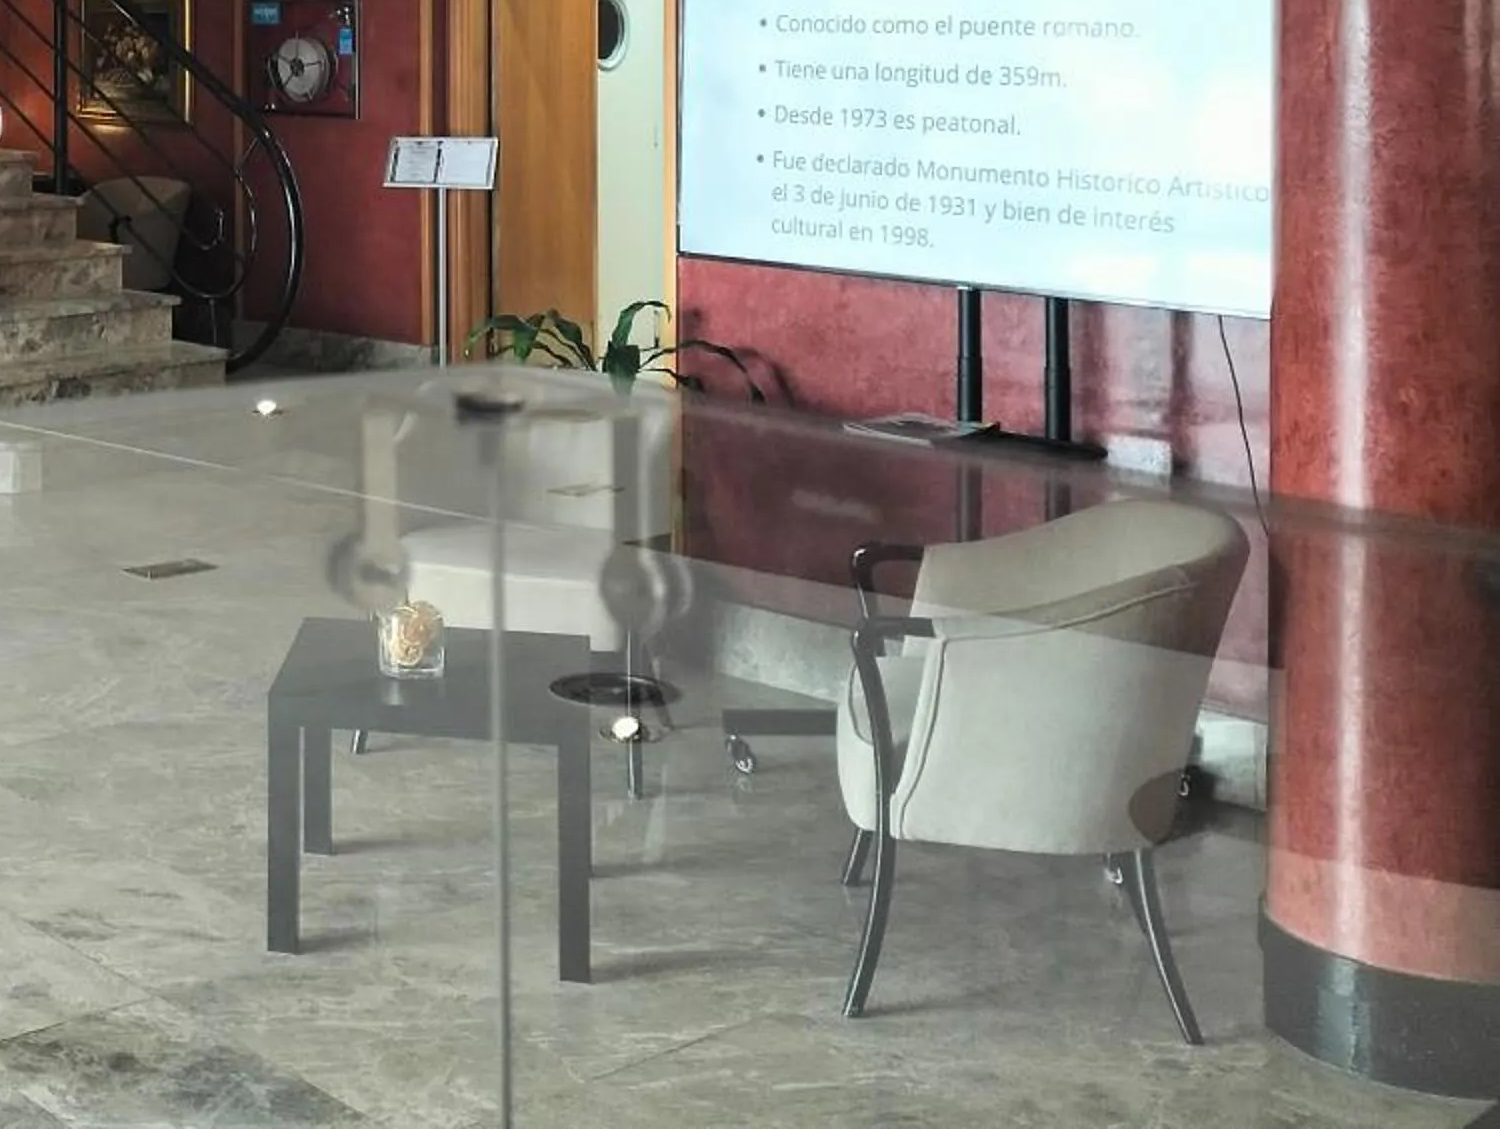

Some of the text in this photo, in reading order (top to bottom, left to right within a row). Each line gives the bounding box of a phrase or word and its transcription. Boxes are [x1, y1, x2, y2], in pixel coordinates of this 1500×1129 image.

[775, 14, 1142, 39] Conocido como el puente romano.
[774, 59, 1068, 89] Tiene una longitud de 359m.
[774, 104, 1022, 137] Desde 1973 es peatonal.
[772, 150, 807, 170] Fue
[811, 152, 911, 178] declarado
[916, 159, 1050, 188] Monumento
[771, 183, 1176, 234] el 3 de junio de 1931 y bien de interés
[771, 215, 935, 249] cultural en 1998.
